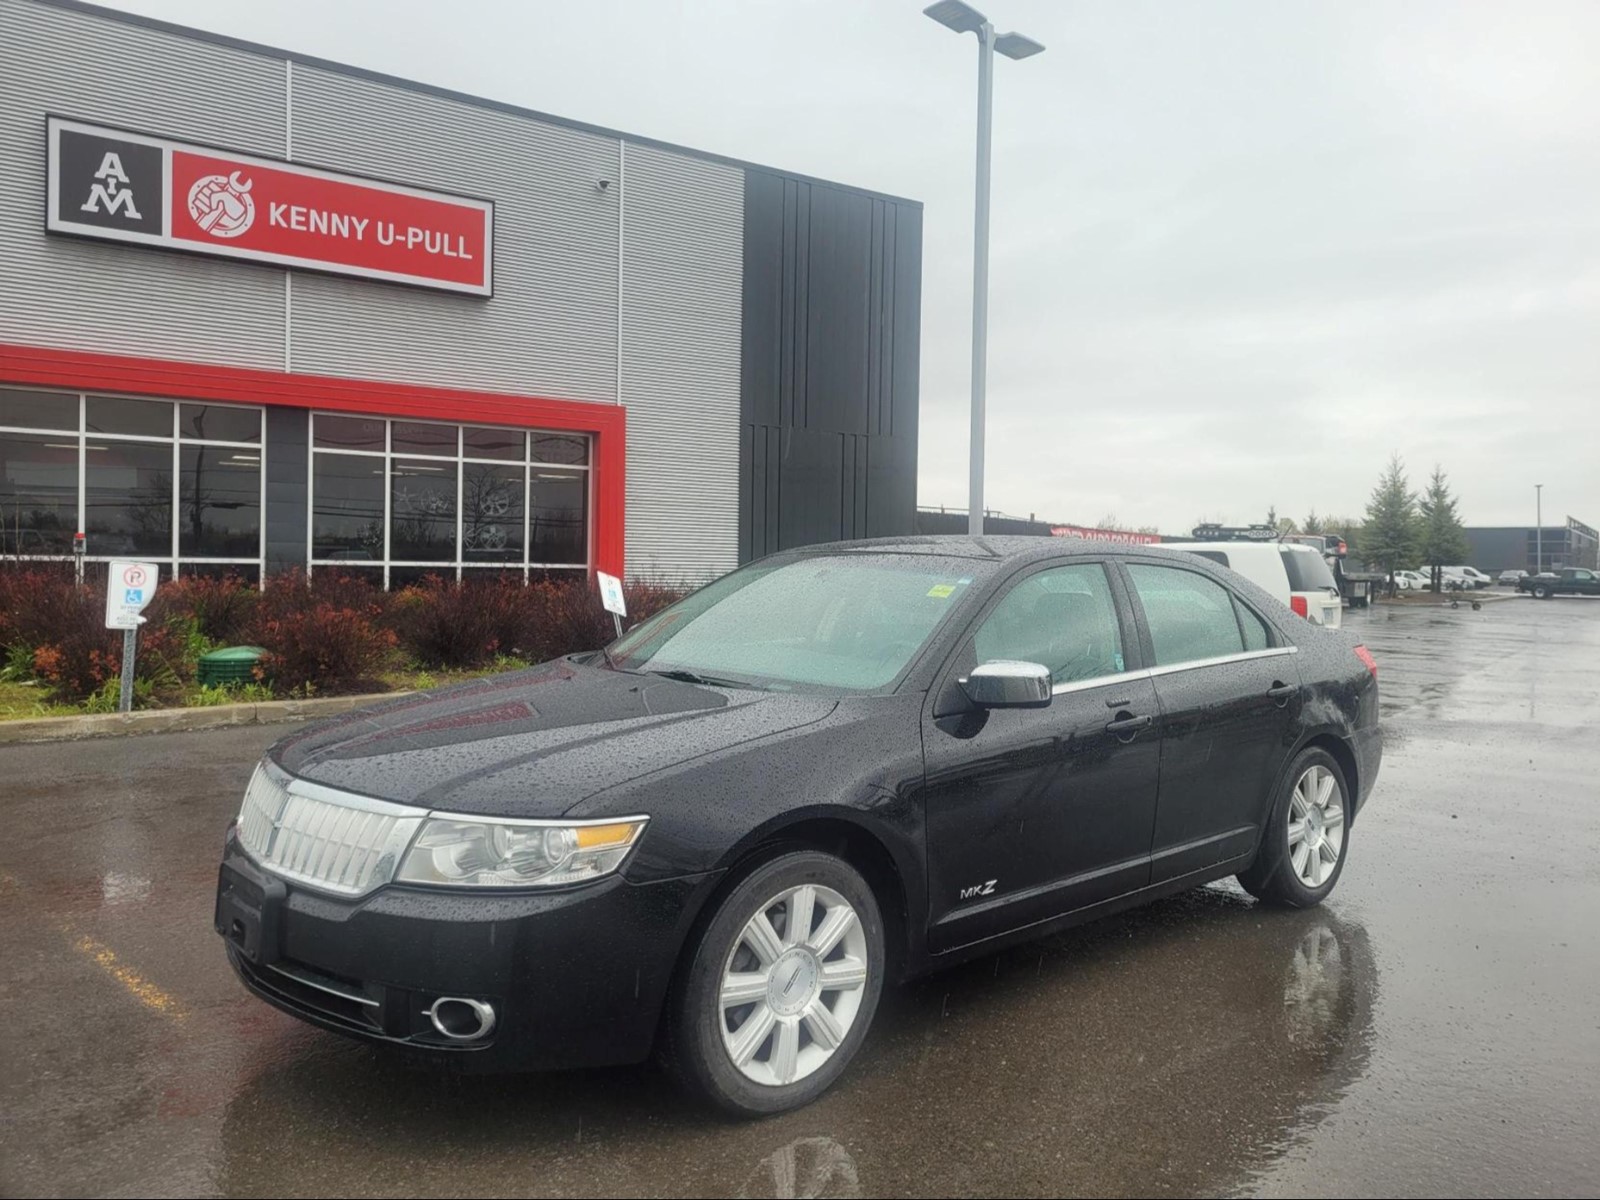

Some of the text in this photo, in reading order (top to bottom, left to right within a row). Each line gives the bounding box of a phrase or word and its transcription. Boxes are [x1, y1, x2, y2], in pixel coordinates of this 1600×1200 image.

[269, 202, 473, 260] KENNY U-PULL
[960, 879, 998, 900] MKZ
